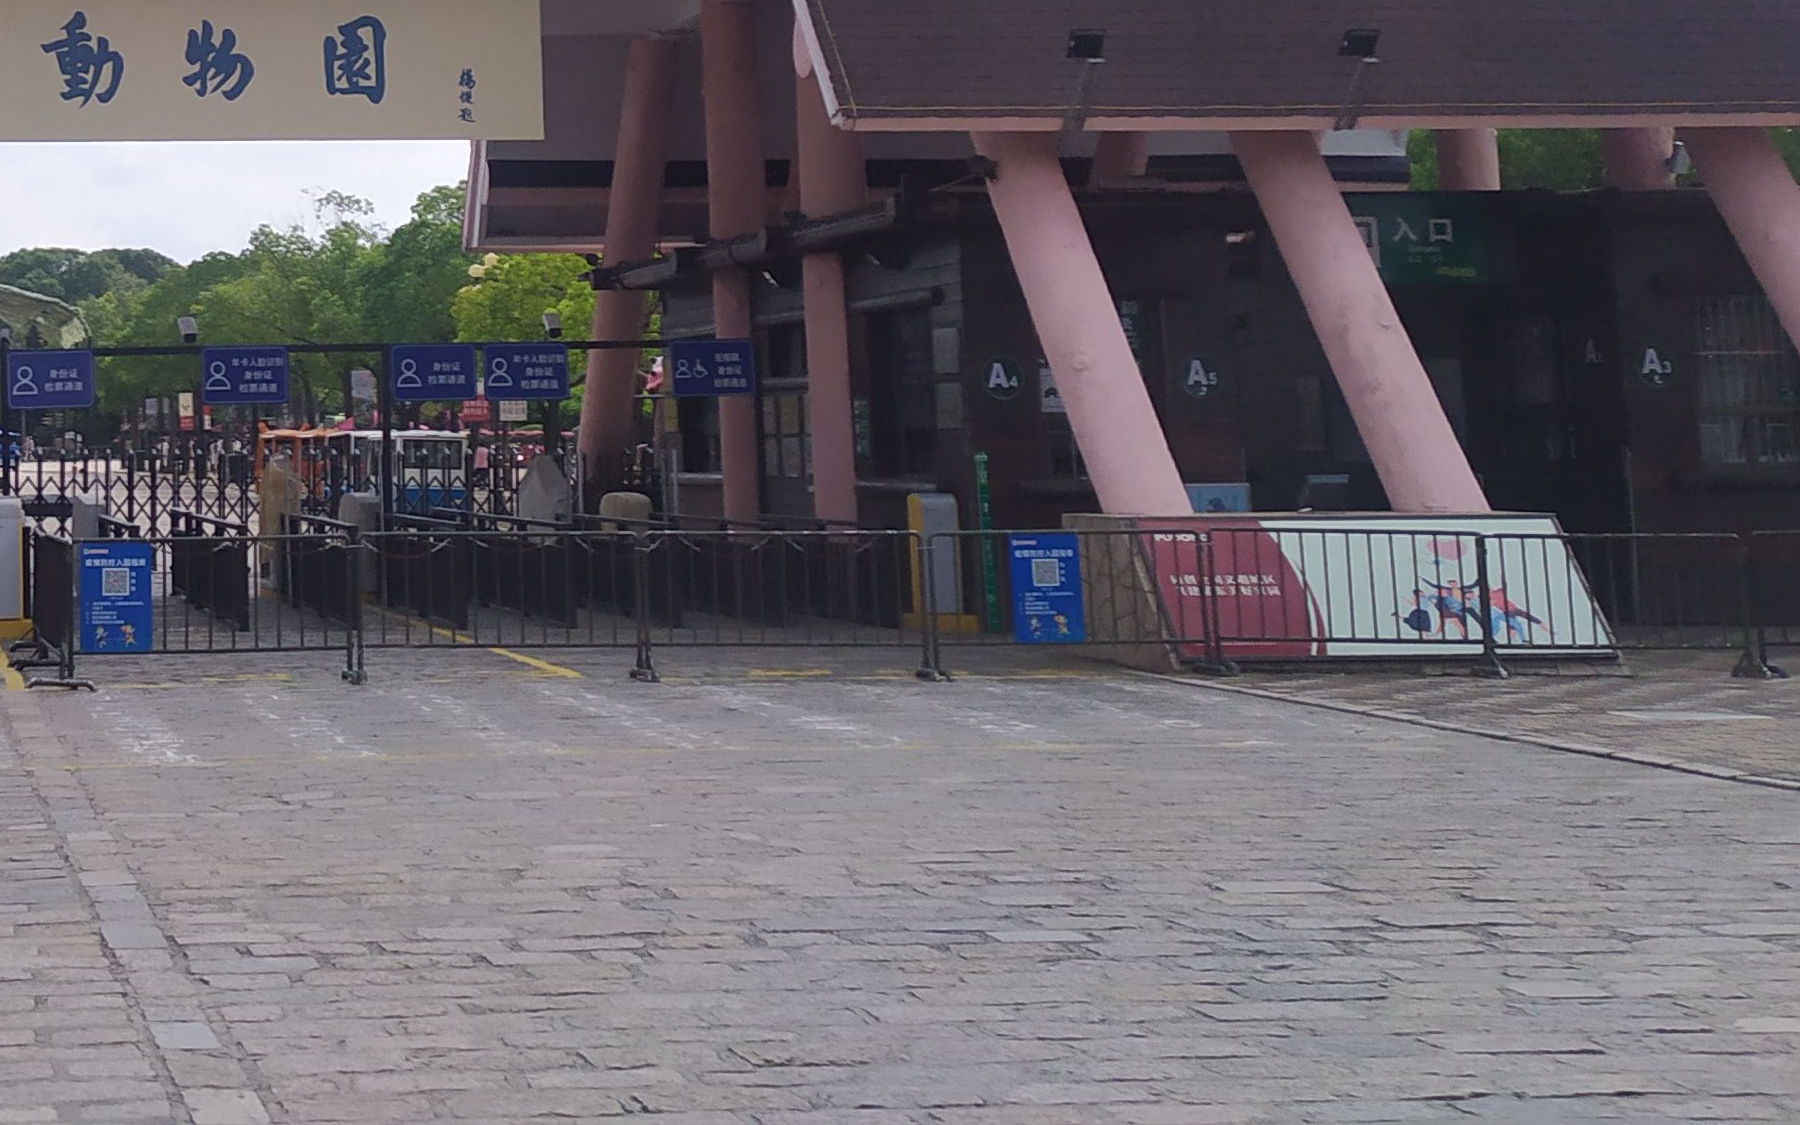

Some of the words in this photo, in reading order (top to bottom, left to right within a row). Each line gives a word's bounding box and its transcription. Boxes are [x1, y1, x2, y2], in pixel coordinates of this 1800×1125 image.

[1392, 216, 1454, 243] 入口
[433, 361, 462, 372] 身份证
[525, 366, 554, 377] 身份证
[50, 368, 78, 379] 身份证
[245, 370, 273, 380] 身份证
